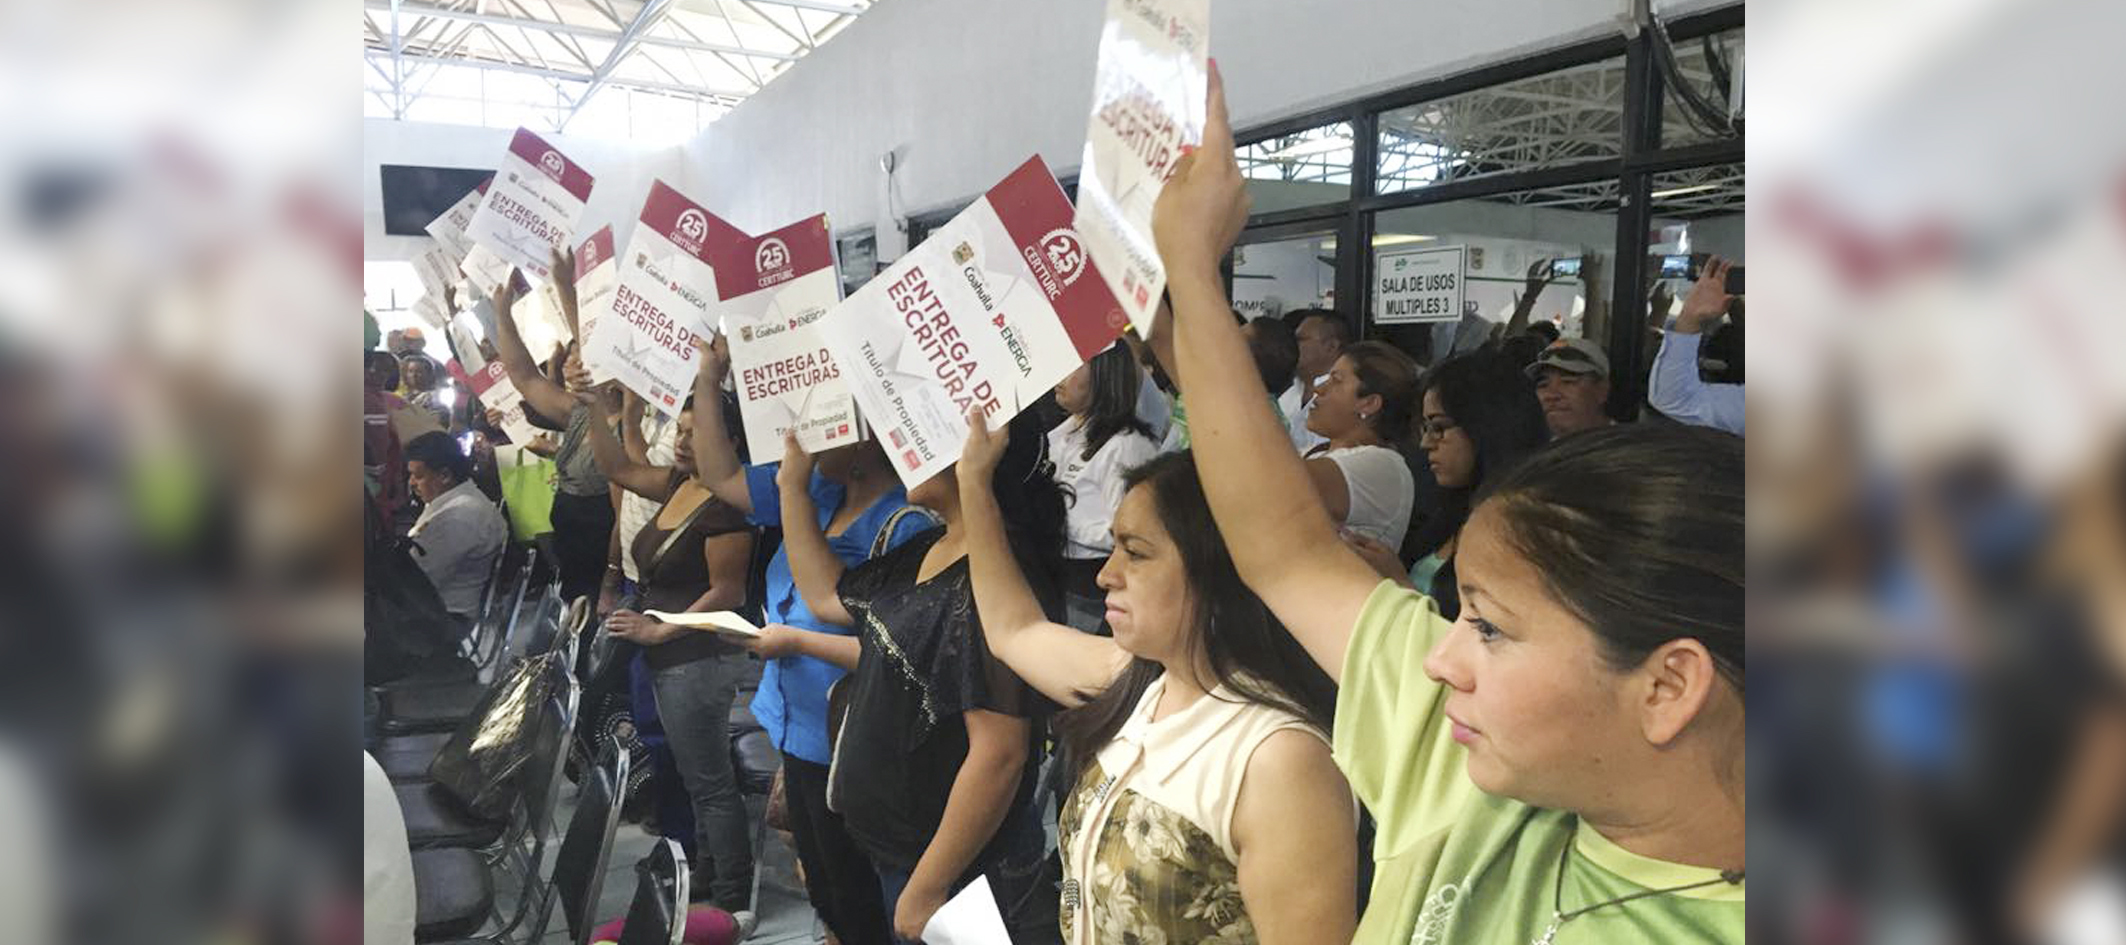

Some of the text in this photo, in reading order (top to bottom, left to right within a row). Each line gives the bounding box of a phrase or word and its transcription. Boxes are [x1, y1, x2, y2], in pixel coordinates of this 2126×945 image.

[489, 200, 561, 249] ESCRITURAS
[493, 190, 548, 231] ENTREGA
[550, 226, 566, 242] DE
[682, 215, 702, 236] 25
[761, 246, 784, 268] 25
[1024, 245, 1062, 302] CERTTURC
[1048, 236, 1080, 273] 25
[963, 265, 993, 312] Coahuila
[1381, 273, 1456, 294] SALA DE USOS
[1385, 297, 1441, 315] MULTIPLES
[1442, 296, 1450, 313] 3
[612, 298, 693, 361] ESCRITURAS
[617, 284, 675, 334] ENTREGA
[677, 326, 701, 349] DE
[904, 265, 977, 380] ENTREGA
[972, 379, 1001, 418] DE
[743, 347, 834, 385] ENTREGA D
[747, 362, 840, 401] ESCRITURAS
[882, 379, 895, 397] de
[892, 396, 936, 462] Propiedad
